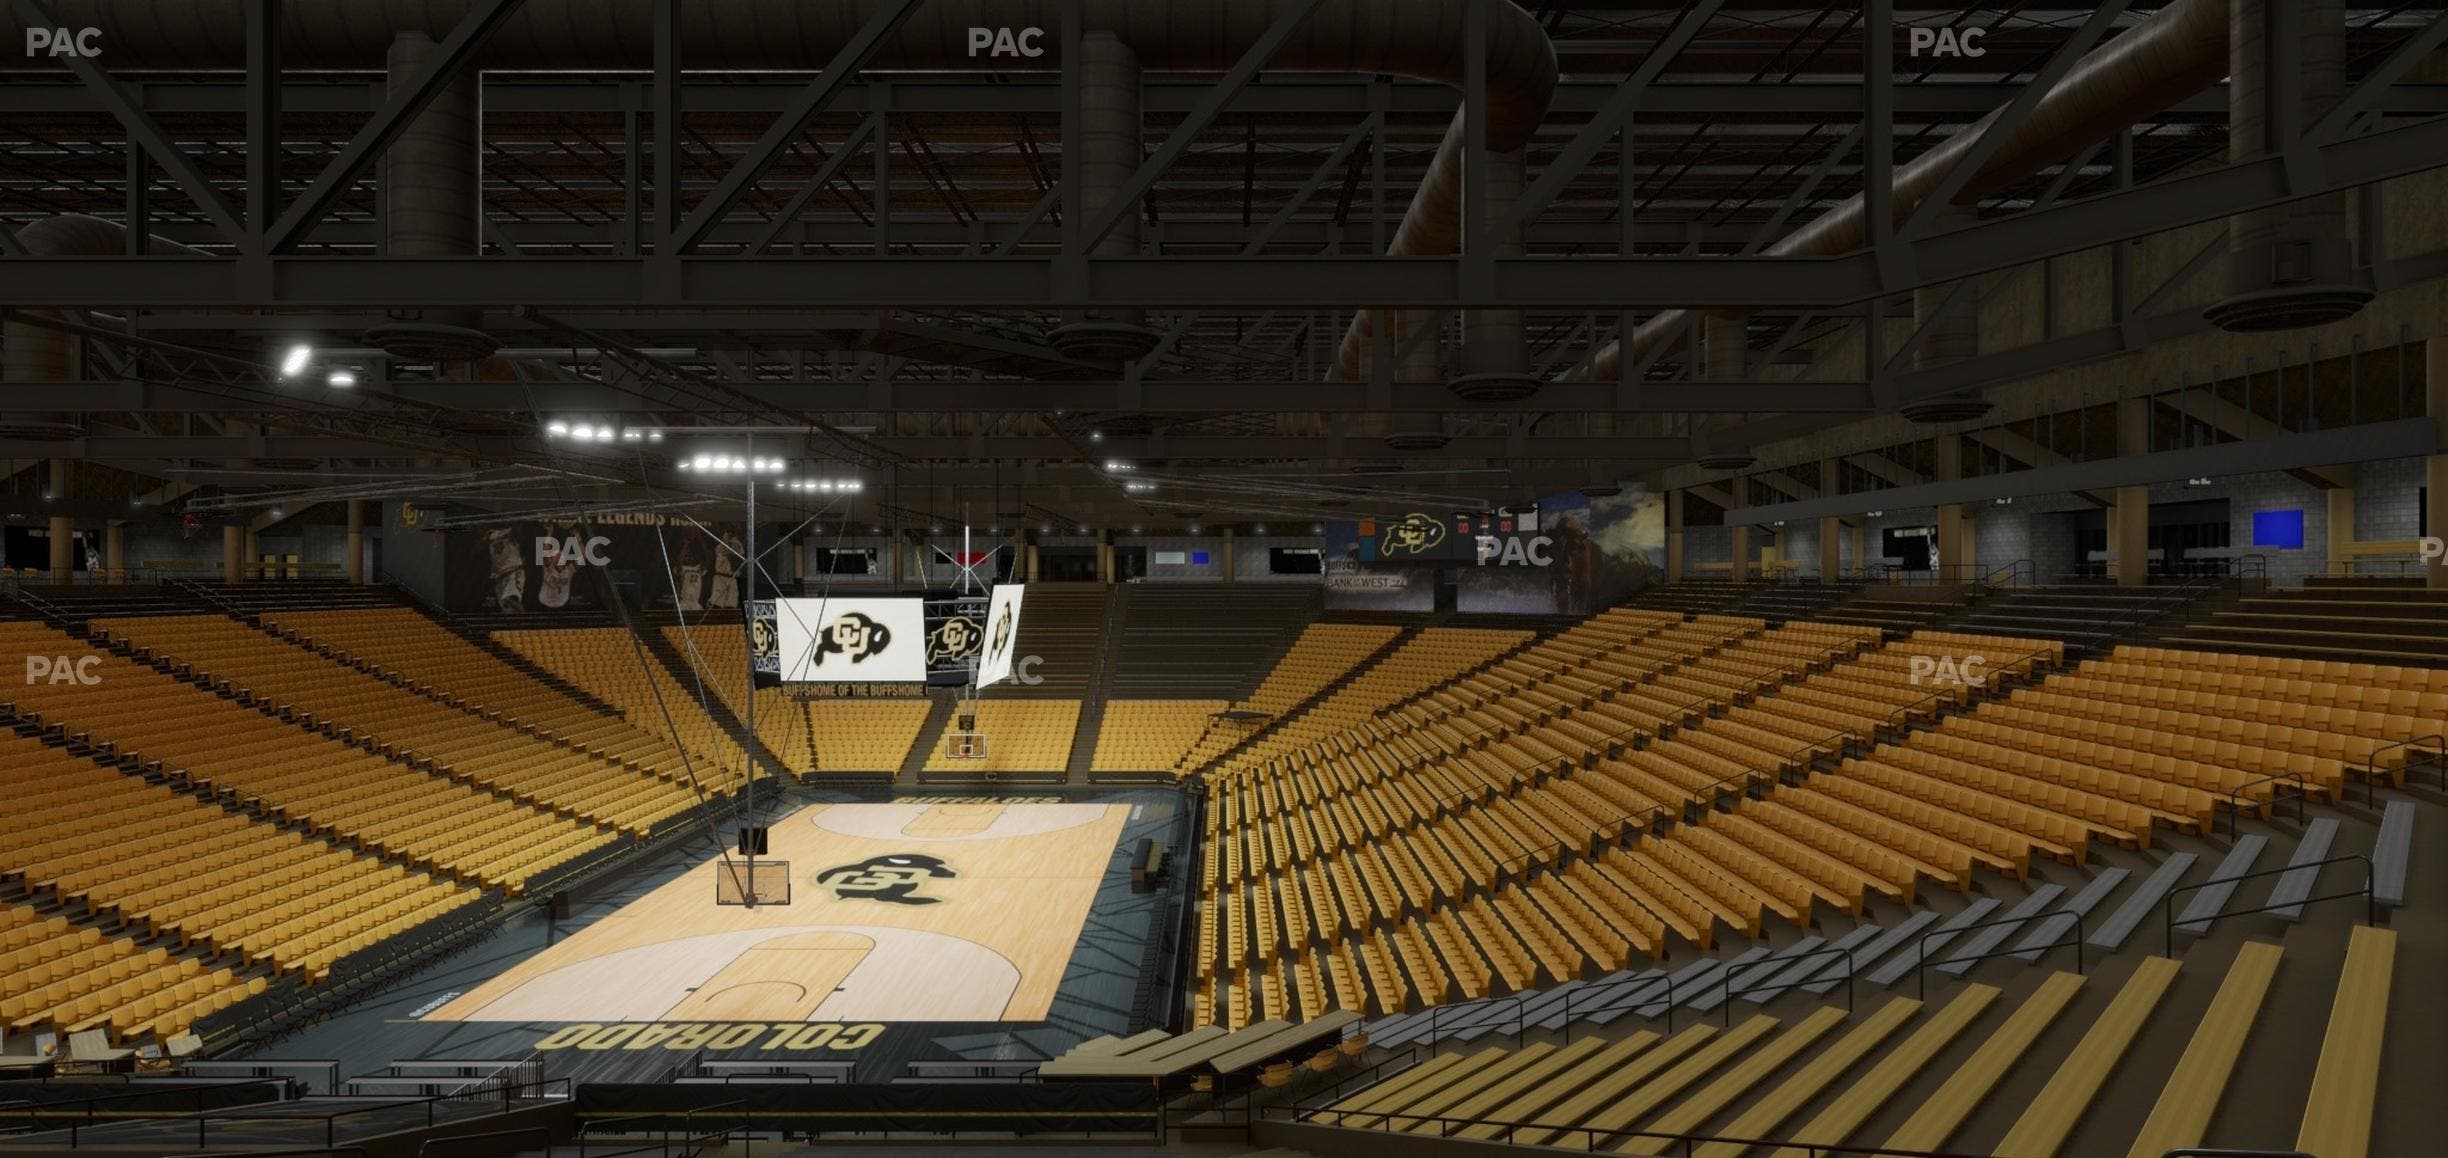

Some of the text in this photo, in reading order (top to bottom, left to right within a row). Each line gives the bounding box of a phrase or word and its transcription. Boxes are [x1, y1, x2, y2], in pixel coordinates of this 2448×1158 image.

[1361, 578, 1388, 590] WEST
[832, 616, 871, 655] CU
[942, 621, 970, 652] CU
[837, 684, 850, 697] OF
[851, 684, 869, 697] THE
[532, 1022, 887, 1051] COLORADO
